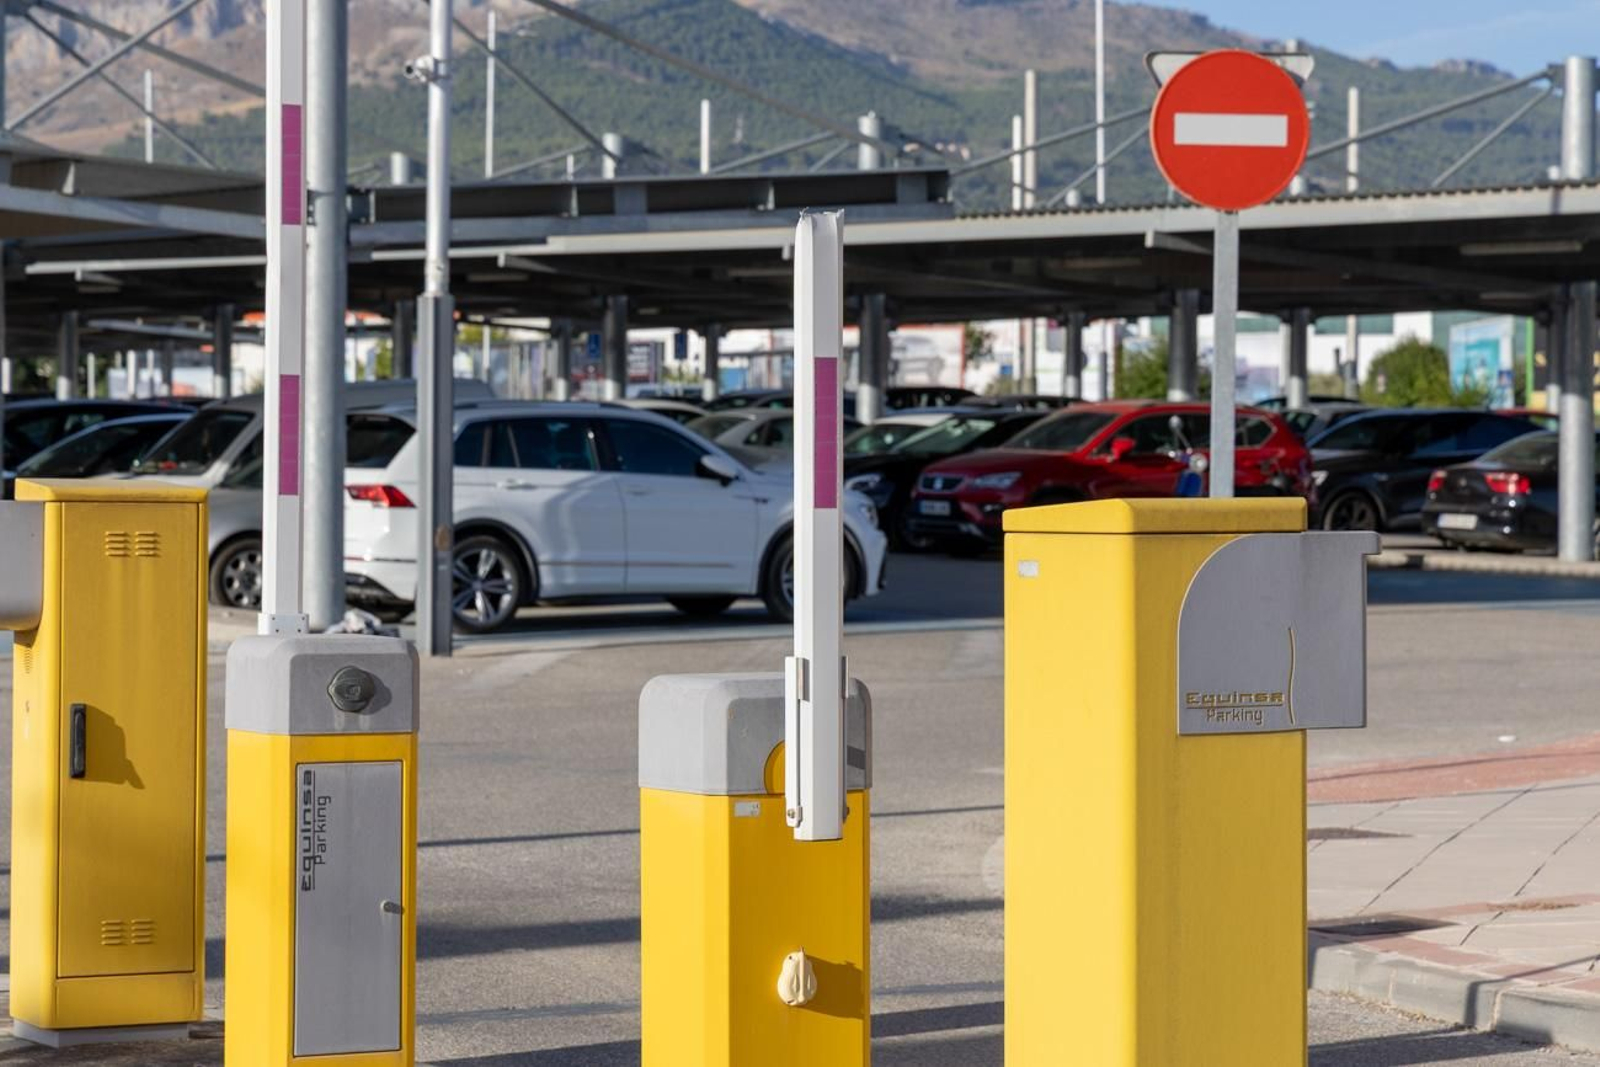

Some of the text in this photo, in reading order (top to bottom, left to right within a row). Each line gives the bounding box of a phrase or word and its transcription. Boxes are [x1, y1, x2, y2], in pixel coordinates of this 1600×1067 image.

[1186, 691, 1283, 708] Equinsa
[1206, 708, 1263, 726] Parking
[301, 770, 314, 891] Equinsa
[314, 795, 332, 865] Parking
